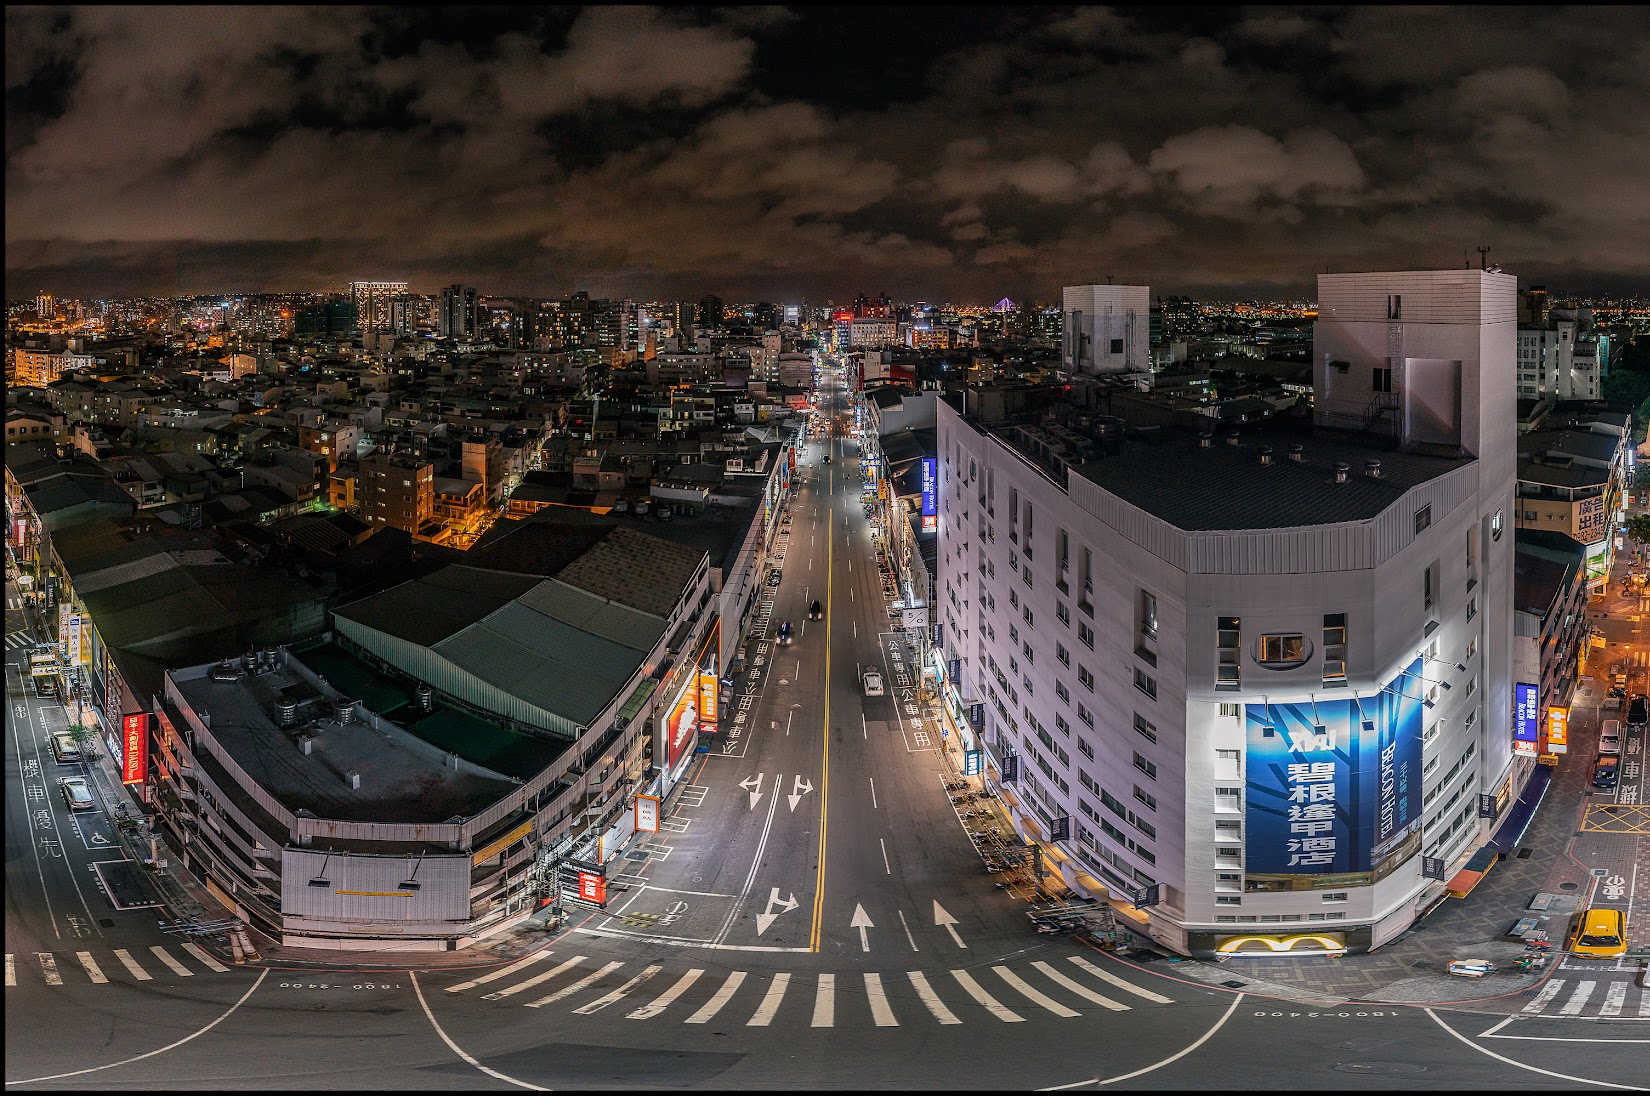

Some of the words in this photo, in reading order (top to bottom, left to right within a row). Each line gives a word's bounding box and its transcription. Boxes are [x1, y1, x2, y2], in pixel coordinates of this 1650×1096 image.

[888, 640, 910, 686] 公車專用
[901, 689, 931, 747] 公車專用
[1381, 740, 1396, 801] BEACON
[1287, 762, 1337, 867] 碧根逢甲酒店
[1381, 795, 1396, 839] HOTEL
